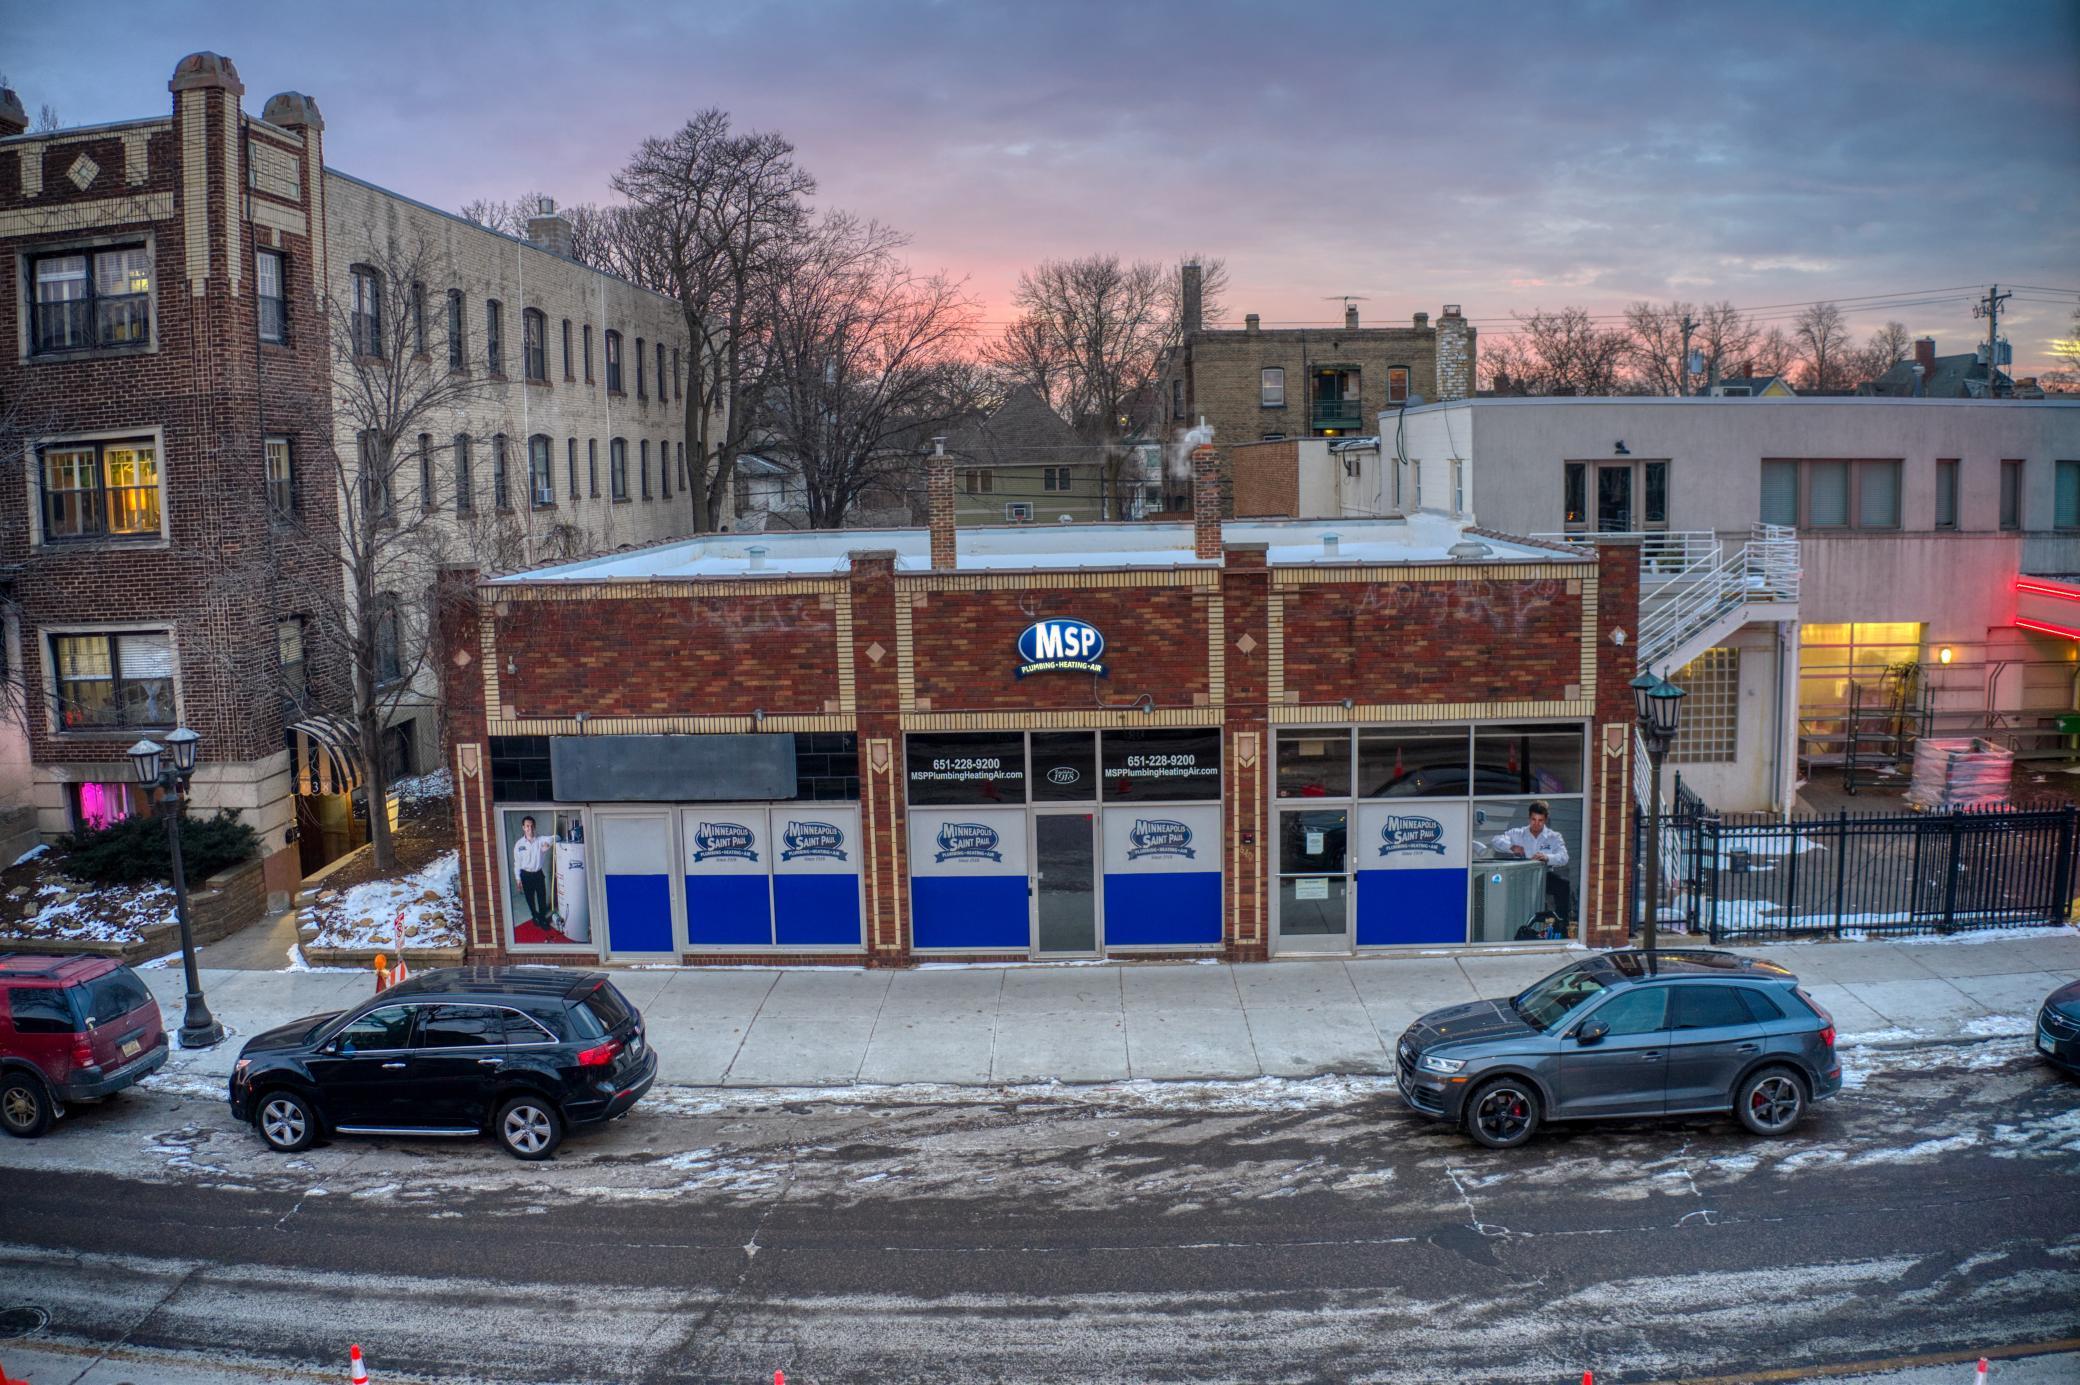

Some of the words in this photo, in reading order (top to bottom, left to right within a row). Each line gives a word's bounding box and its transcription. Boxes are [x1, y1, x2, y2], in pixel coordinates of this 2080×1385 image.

[1036, 623, 1095, 659] MSP
[1021, 662, 1055, 673] PLUMBING
[1059, 661, 1087, 670] HEATING
[1090, 664, 1102, 672] AIR
[933, 758, 1000, 770] 651-228-9200
[1127, 754, 1195, 767] 651-228-9200
[911, 770, 1023, 781] MSPPlumbingHeatingAir.com
[1105, 767, 1218, 777] MSPPlumbingHeatingAir.com
[700, 823, 748, 838] MINNEAPOLIS
[789, 822, 837, 837] MINNEAPOLIS
[943, 823, 992, 838] MINNEAPOLIS
[1136, 820, 1185, 835] MINNEAPOLIS
[1388, 816, 1437, 831] MINNEAPOLIS
[707, 837, 731, 851] SAINT
[732, 837, 747, 846] PAUL
[795, 837, 819, 850] SAINT
[821, 836, 835, 846] PAUL
[950, 838, 974, 851] SAINT
[976, 837, 990, 847] PAUL
[1143, 835, 1168, 849] SAINT
[1169, 834, 1183, 844] PAUL
[1394, 831, 1419, 844] SAINT
[1420, 830, 1434, 839] PAUL
